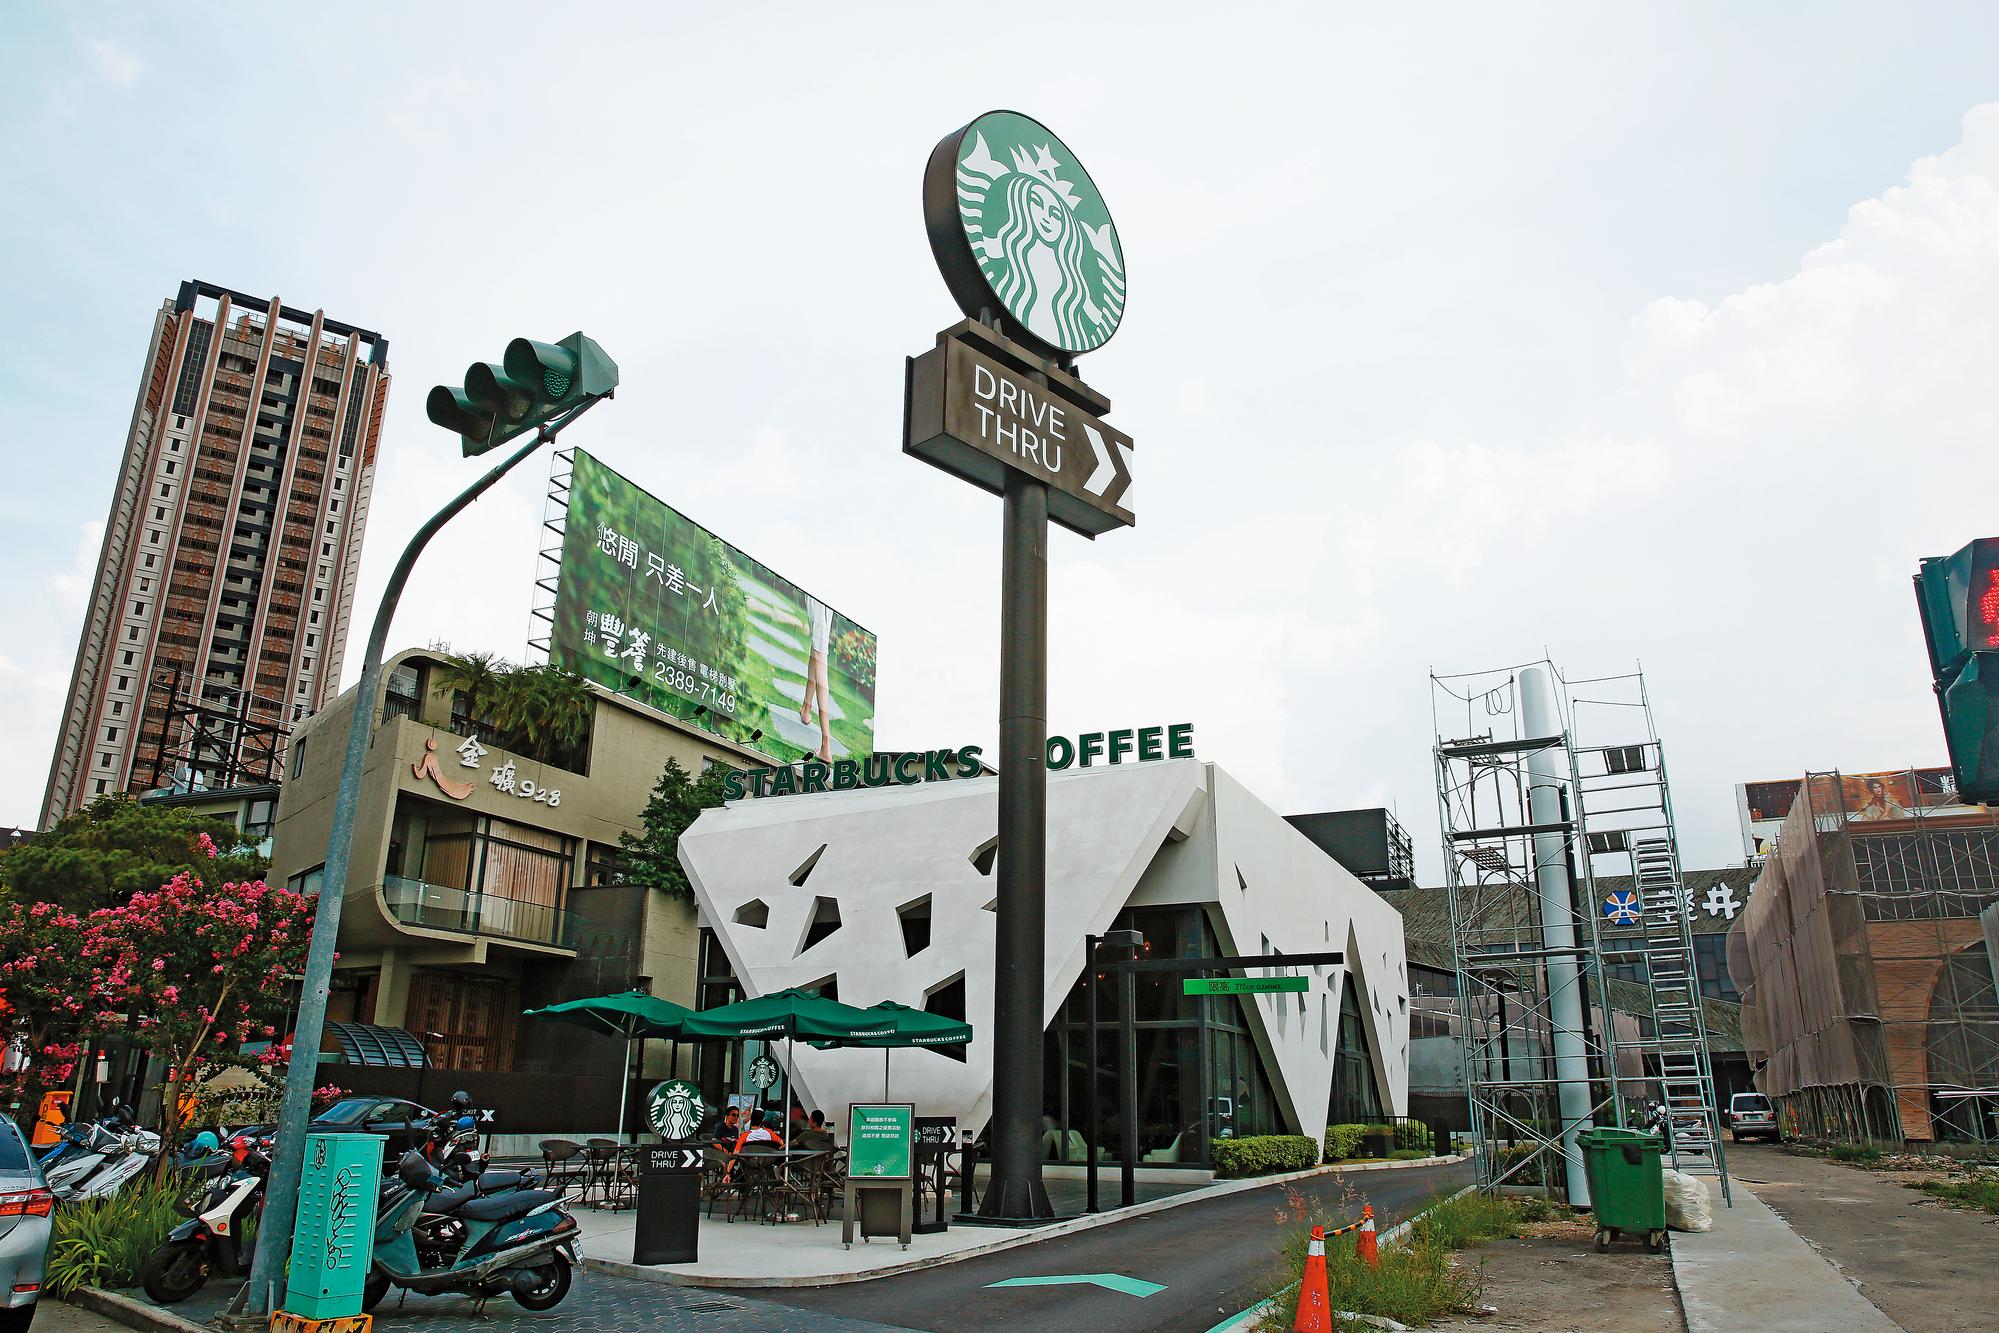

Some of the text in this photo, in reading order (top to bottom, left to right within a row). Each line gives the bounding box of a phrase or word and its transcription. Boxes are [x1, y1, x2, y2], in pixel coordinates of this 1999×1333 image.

[974, 364, 1066, 441] DRIVE
[974, 402, 1061, 473] THRU
[596, 521, 720, 616] 悠閒 只差一人
[583, 609, 599, 647] 朝坤
[656, 641, 698, 674] 先建後售
[655, 661, 736, 713] 2389-7149
[722, 722, 1195, 801] STARBUCKS OFFEE
[1208, 981, 1230, 992] 限高
[922, 1126, 941, 1135] DRIVE
[922, 1135, 940, 1144] THRU
[651, 1150, 679, 1159] DRIVE
[651, 1160, 676, 1168] THRU
